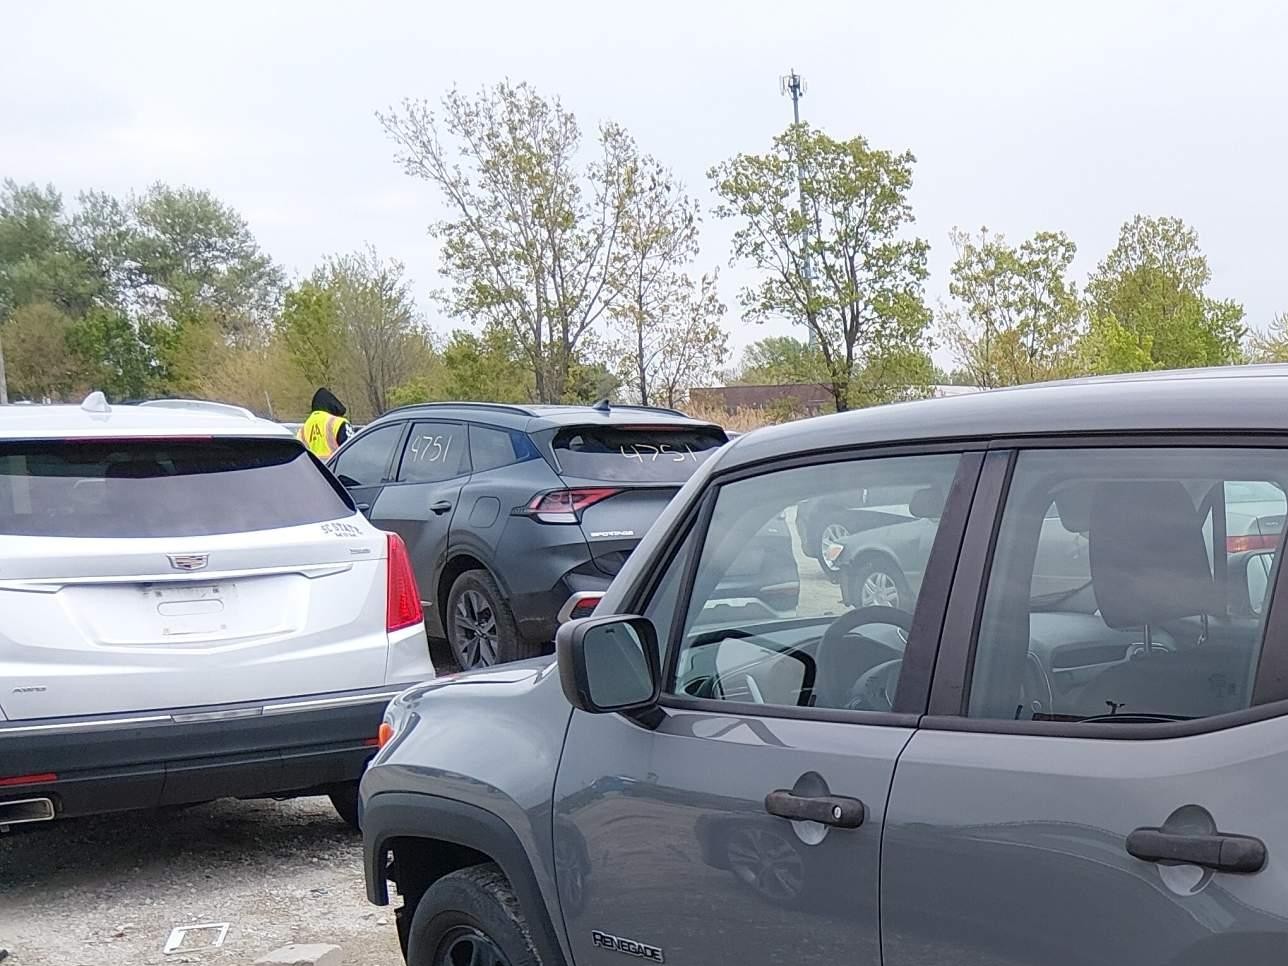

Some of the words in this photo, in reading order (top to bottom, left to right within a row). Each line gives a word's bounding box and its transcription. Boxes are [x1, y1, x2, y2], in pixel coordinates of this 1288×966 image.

[411, 434, 453, 463] 4751
[620, 443, 698, 464] 4751
[591, 929, 665, 964] RENEGADE
